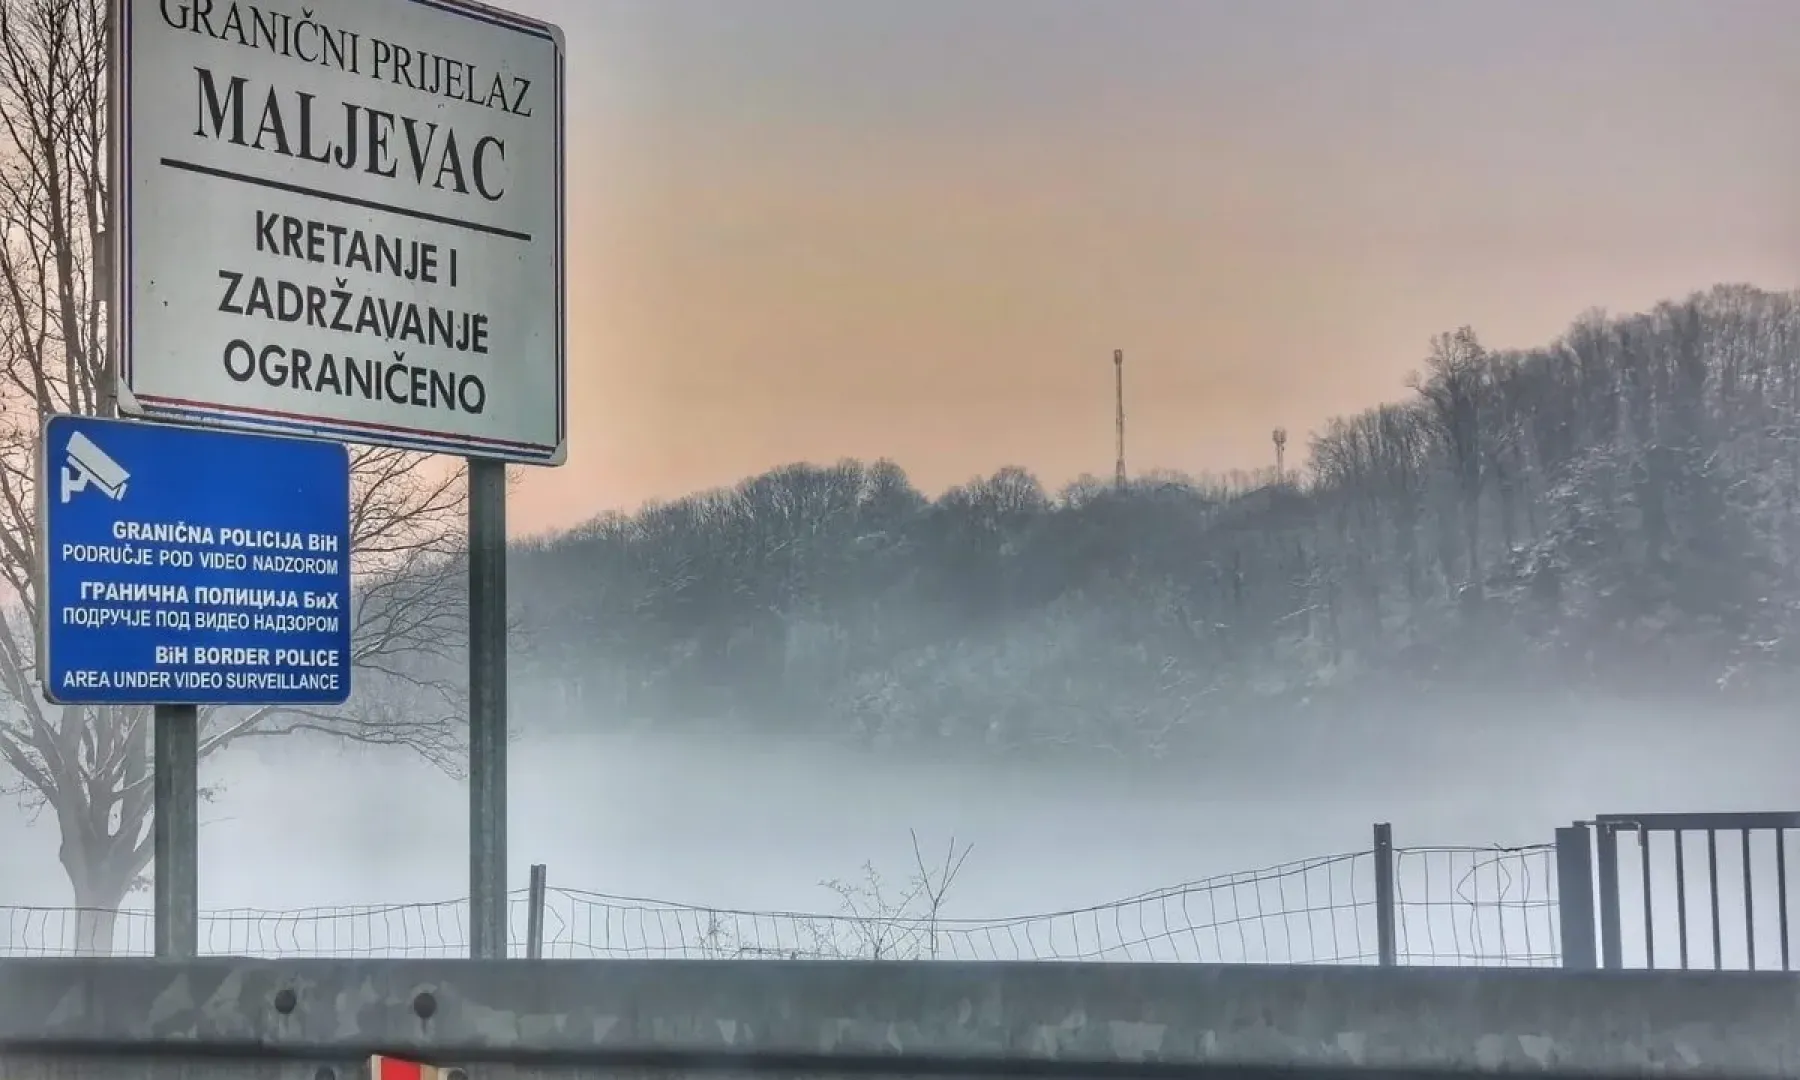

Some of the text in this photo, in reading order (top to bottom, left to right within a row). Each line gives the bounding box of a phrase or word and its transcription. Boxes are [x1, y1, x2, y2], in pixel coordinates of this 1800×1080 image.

[160, 0, 532, 118] GRANIČNI PRIJELAZ
[193, 66, 505, 201] MALJEVAC
[256, 210, 458, 287] KRETANJE I
[218, 269, 489, 354] ZADRŽAVANJE
[223, 338, 487, 414] OGRANIČENO
[113, 521, 338, 552] GRANIČNA POLICIJA BiH
[62, 543, 338, 575] PODRUČJE POD VIDEO NADZOROM
[80, 581, 338, 610] ГРАНИЧНА ПОЛИЦИЈА БиХ
[63, 607, 338, 634] ПОДРУЧЈЕ ПОД ВИДЕО НАДЗОРОМ
[155, 646, 339, 667] BiH BORDER POLICE
[63, 670, 339, 690] AREA UNDER VIDEO SURVEILLANCE
